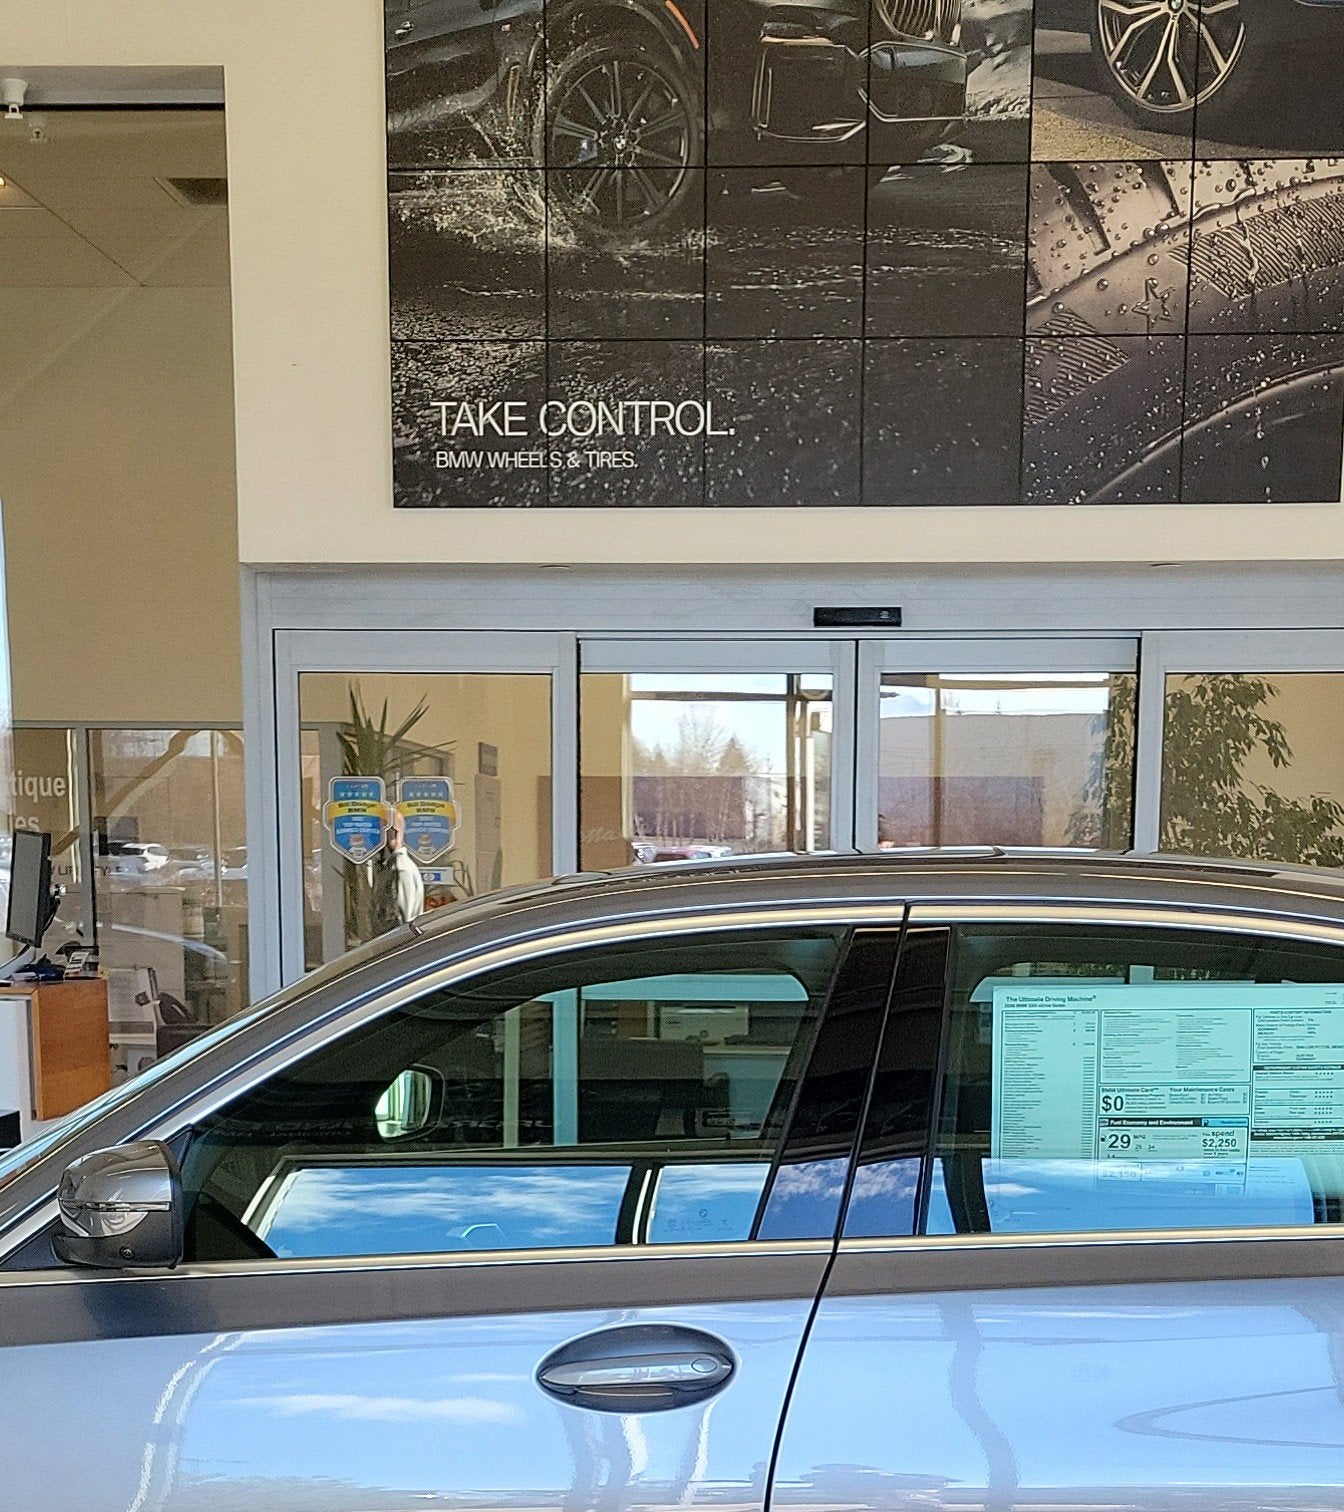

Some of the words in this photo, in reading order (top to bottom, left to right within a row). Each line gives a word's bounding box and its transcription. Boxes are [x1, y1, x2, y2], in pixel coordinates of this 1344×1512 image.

[429, 400, 528, 437] TAKE
[539, 400, 736, 437] CONTROL.
[436, 451, 482, 469] BMW
[489, 451, 562, 469] WHEELS
[566, 451, 581, 469] &
[587, 451, 639, 469] TIRES.
[1101, 1095, 1124, 1113] $0
[1108, 1133, 1131, 1149] 29
[1202, 1138, 1237, 1149] $2,250
